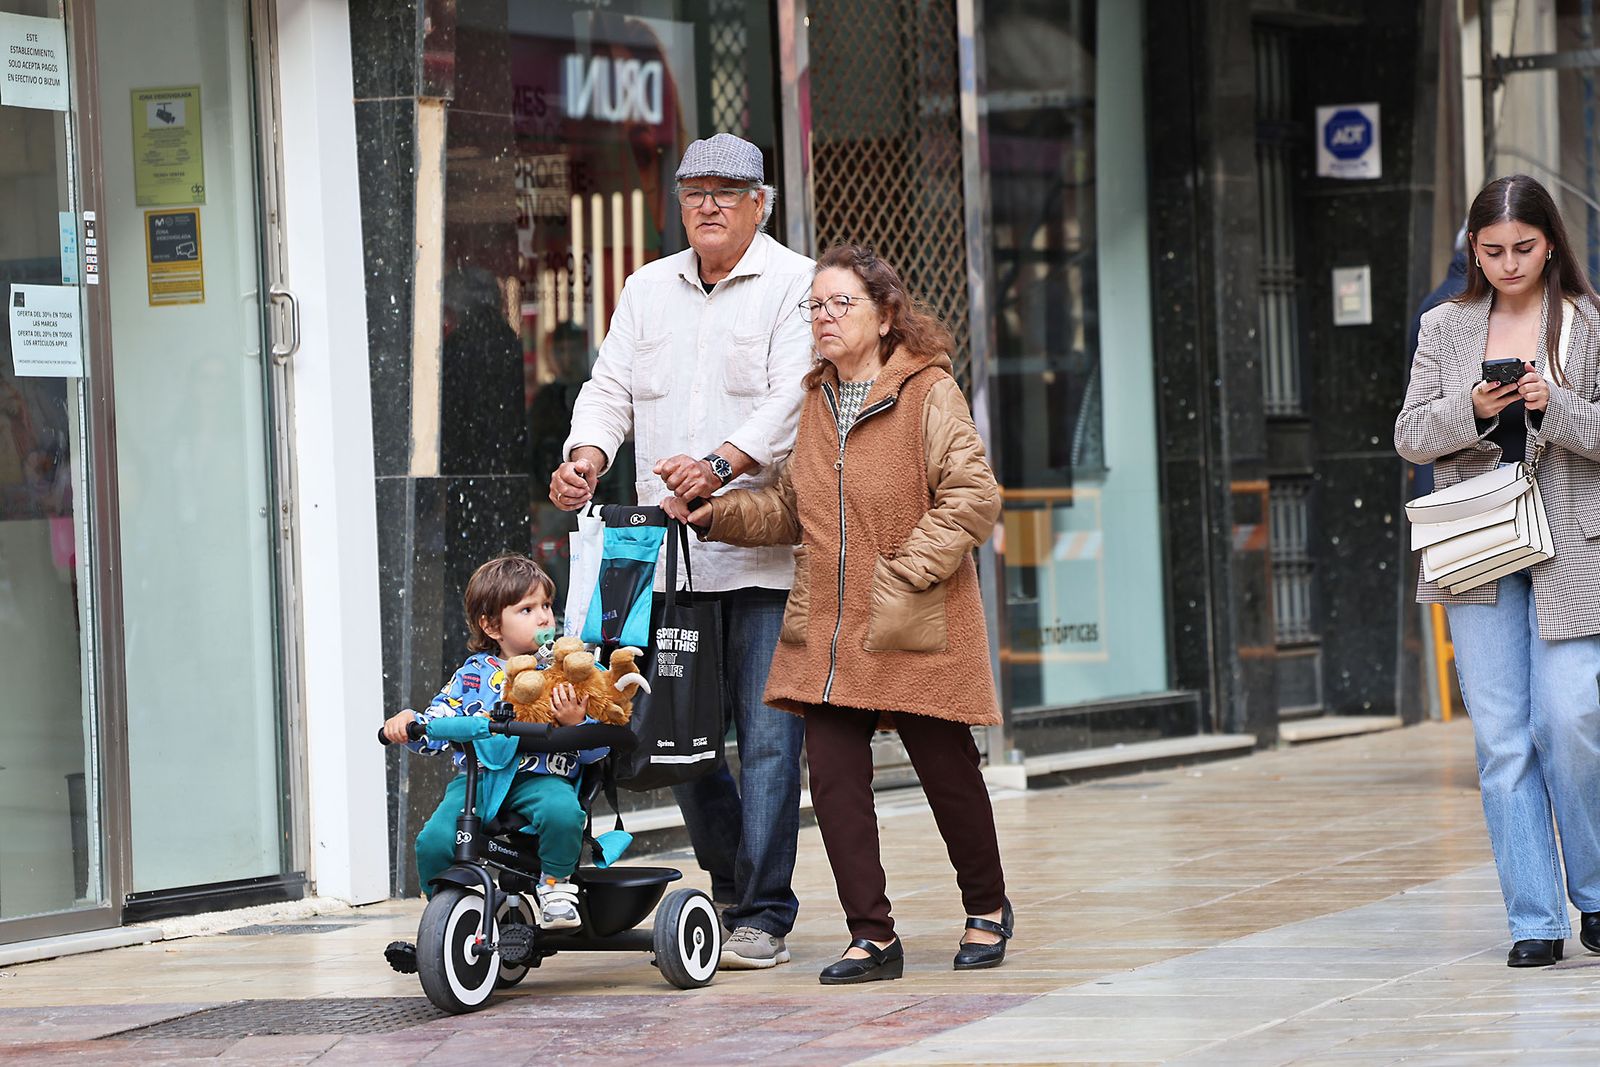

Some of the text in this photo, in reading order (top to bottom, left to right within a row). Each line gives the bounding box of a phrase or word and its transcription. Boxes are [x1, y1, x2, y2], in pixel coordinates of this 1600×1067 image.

[26, 33, 38, 42] ESTE
[10, 45, 56, 59] ESTABLECIMIENTO,
[8, 59, 58, 73] SOLO ACEPTA PAGOS
[7, 73, 61, 87] EN EFECTIVO O BIZUM
[1332, 124, 1365, 146] ADT
[16, 310, 33, 318] OFERTA
[59, 331, 73, 339] TODOS
[656, 627, 680, 640] SPRT
[674, 639, 696, 653] THIS
